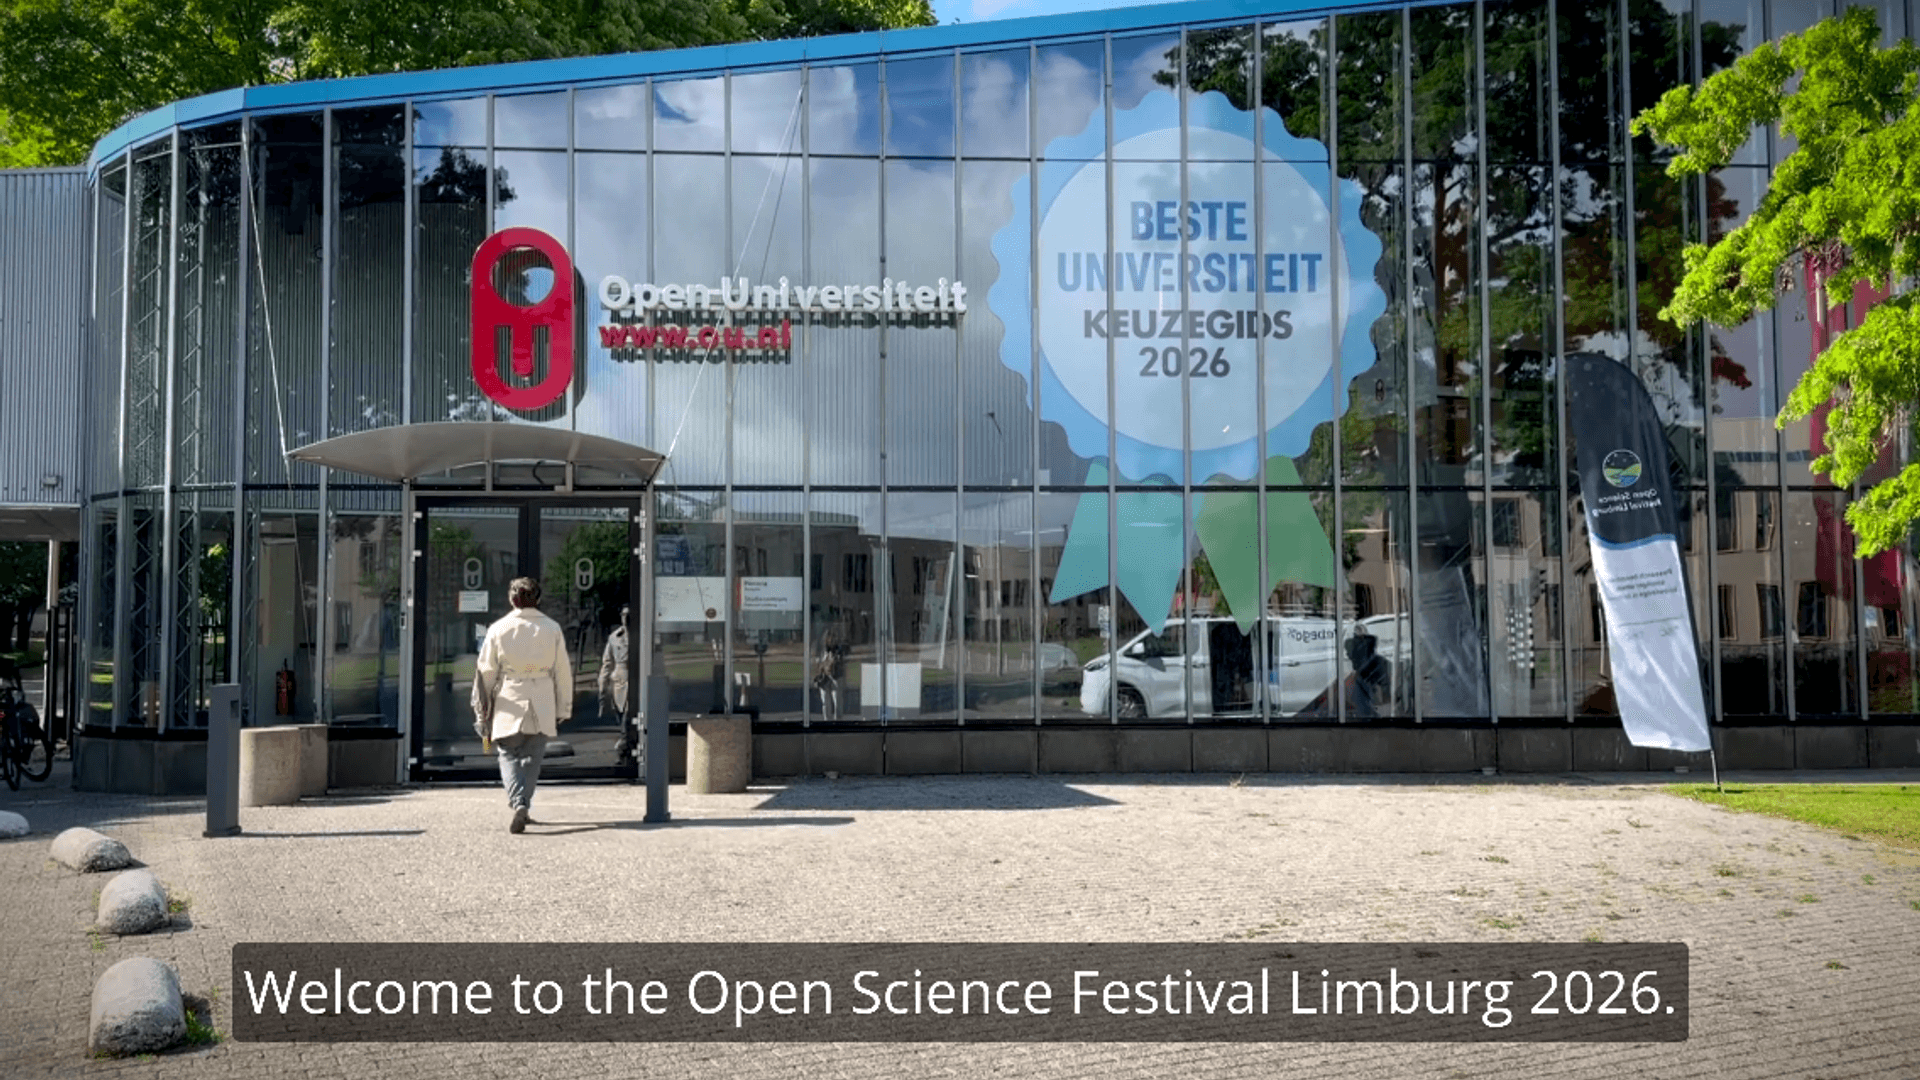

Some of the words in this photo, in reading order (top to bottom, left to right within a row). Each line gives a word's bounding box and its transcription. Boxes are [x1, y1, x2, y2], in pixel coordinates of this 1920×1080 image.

[1130, 201, 1248, 242] BESTE
[1057, 252, 1322, 293] UNIVERSITEIT
[598, 275, 711, 316] Open
[721, 275, 968, 312] Universiteit
[598, 319, 791, 349] www.ou.nl
[1084, 309, 1293, 339] KEUZEGIDS
[1139, 346, 1230, 377] 2026
